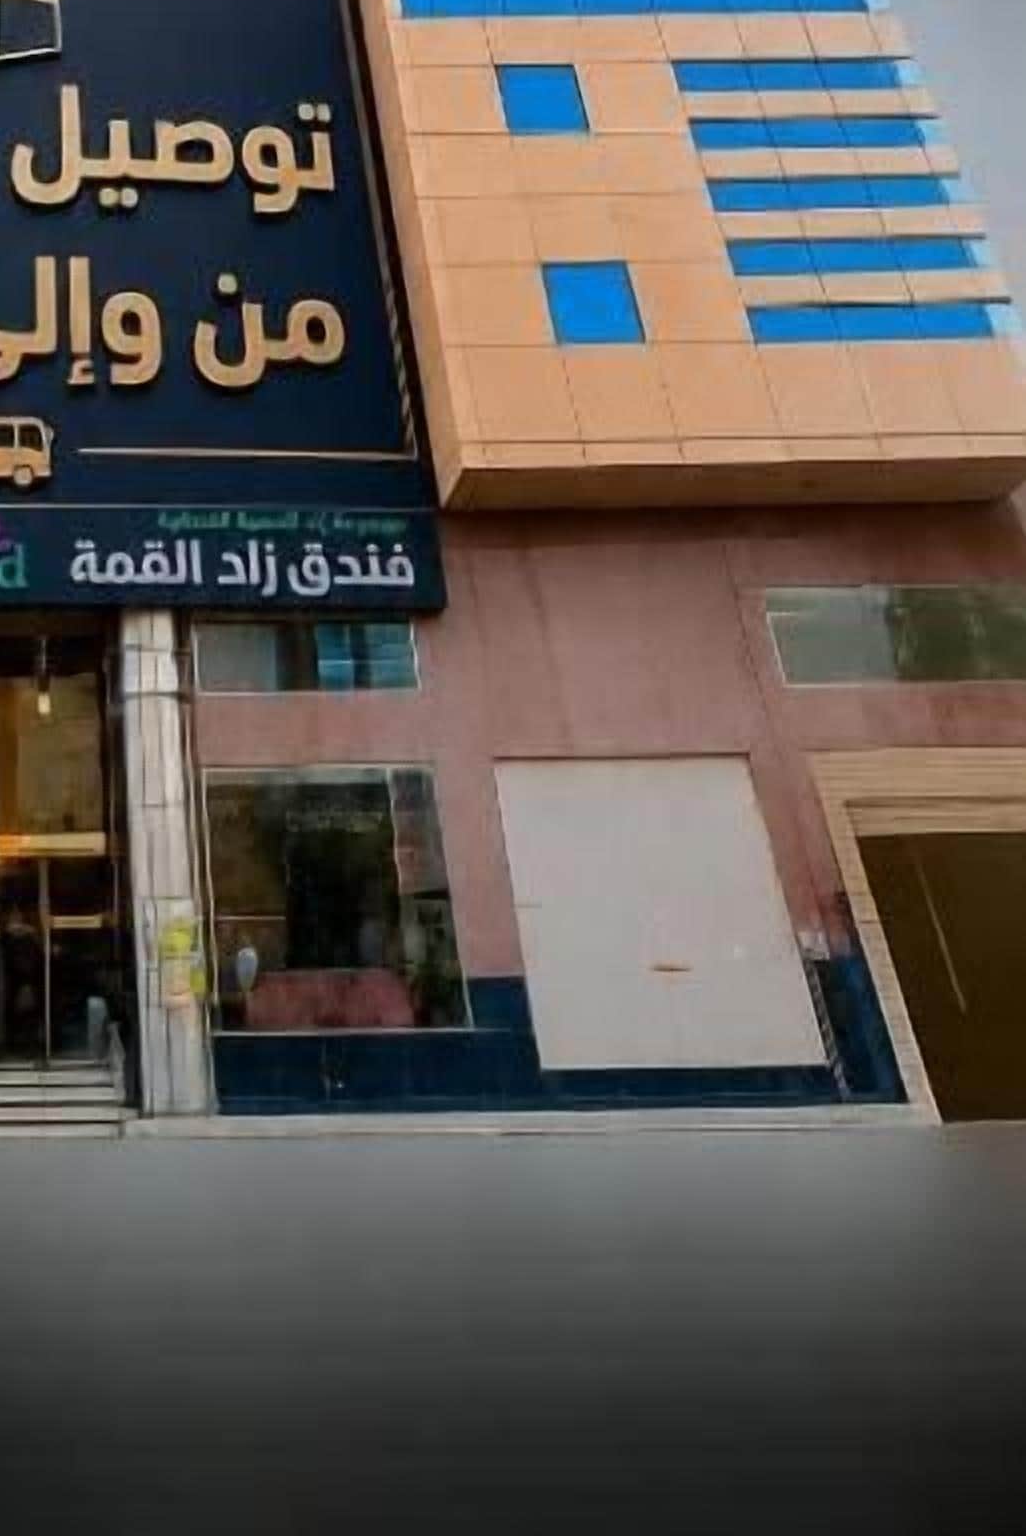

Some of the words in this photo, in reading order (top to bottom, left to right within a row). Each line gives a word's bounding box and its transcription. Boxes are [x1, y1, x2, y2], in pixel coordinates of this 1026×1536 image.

[11, 83, 335, 214] توصيل
[193, 272, 345, 388] من
[70, 539, 203, 585] القمة
[218, 539, 278, 597] زاد
[287, 543, 415, 596] فندق
